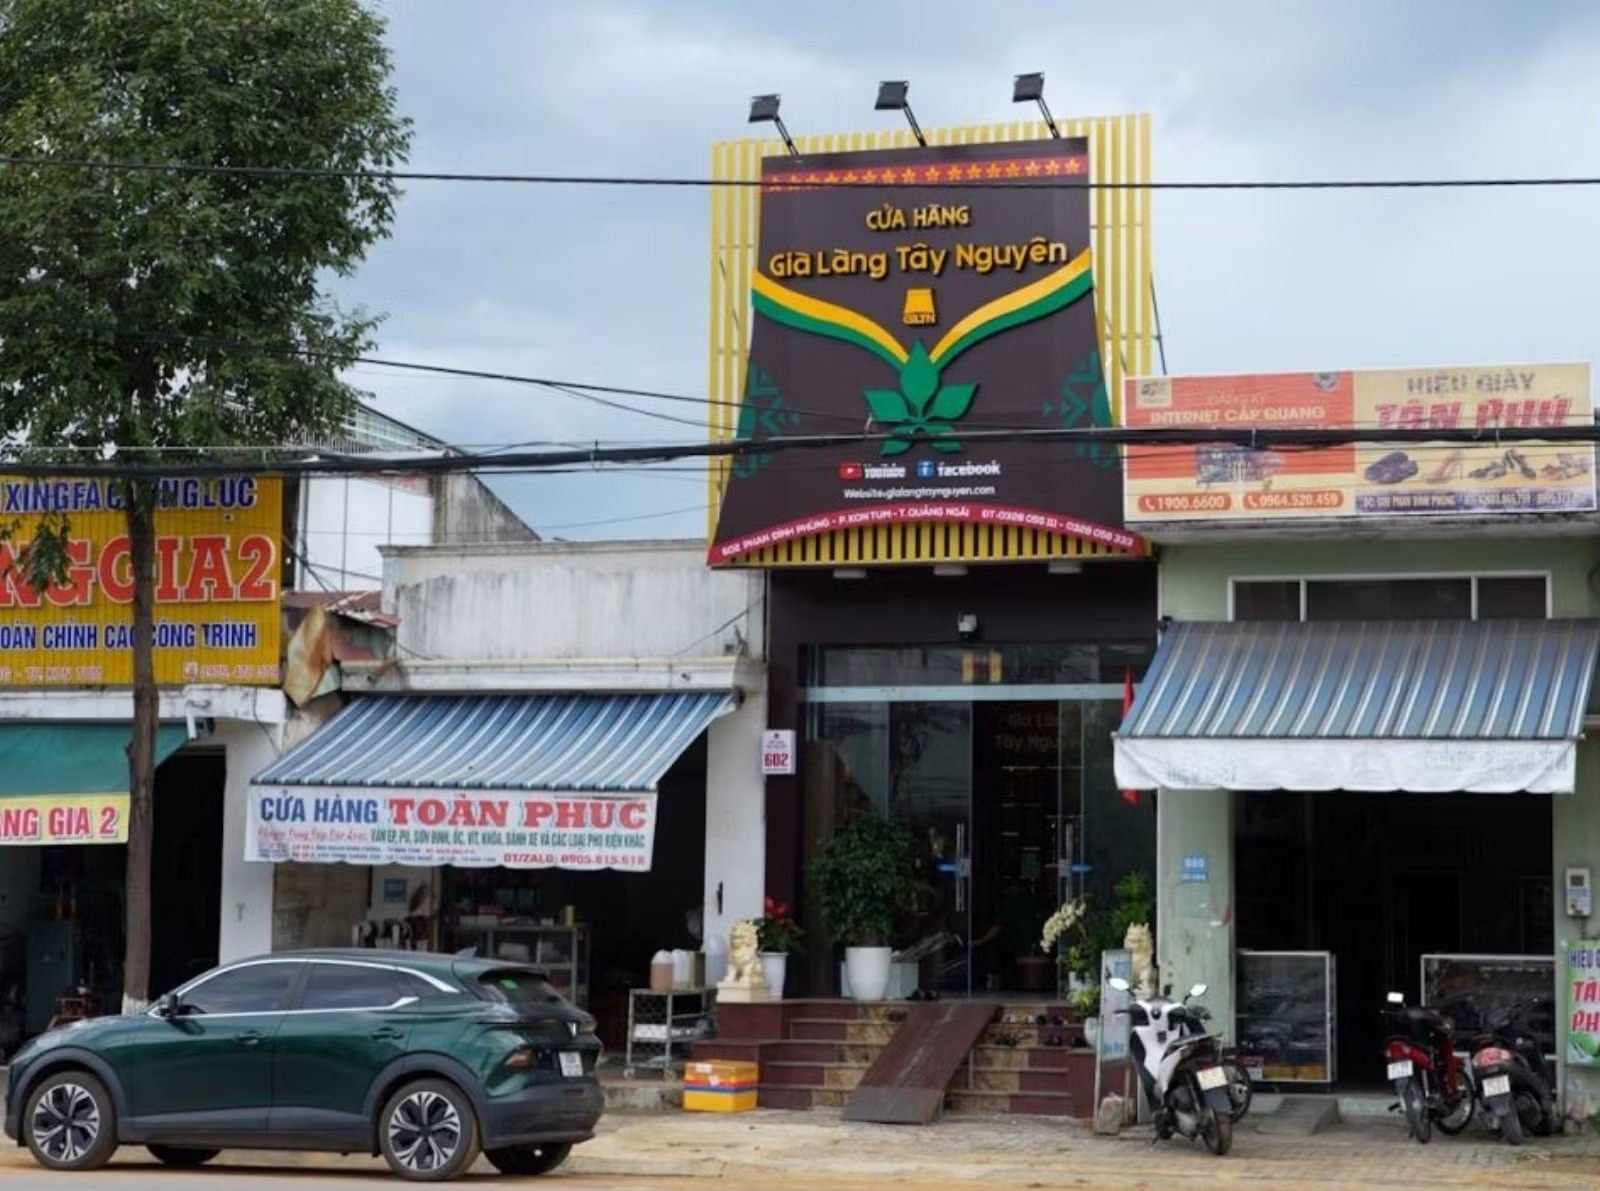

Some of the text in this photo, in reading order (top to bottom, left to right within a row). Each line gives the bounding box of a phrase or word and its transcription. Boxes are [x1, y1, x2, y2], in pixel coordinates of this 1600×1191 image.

[866, 203, 906, 230] CỬA
[769, 236, 1067, 279] Già Làng Tây Nguyên
[1151, 410, 1218, 425] INTERNET
[937, 460, 1001, 477] facebook
[6, 480, 101, 511] XINGFA
[1157, 495, 1225, 510] 1900.6600
[202, 618, 257, 647] TRÌNH
[765, 752, 788, 767] 602
[0, 806, 116, 837] NG GIA 2
[260, 790, 306, 822] CỬA
[388, 793, 509, 827] TOÀN
[1574, 976, 1600, 1002] TÂ
